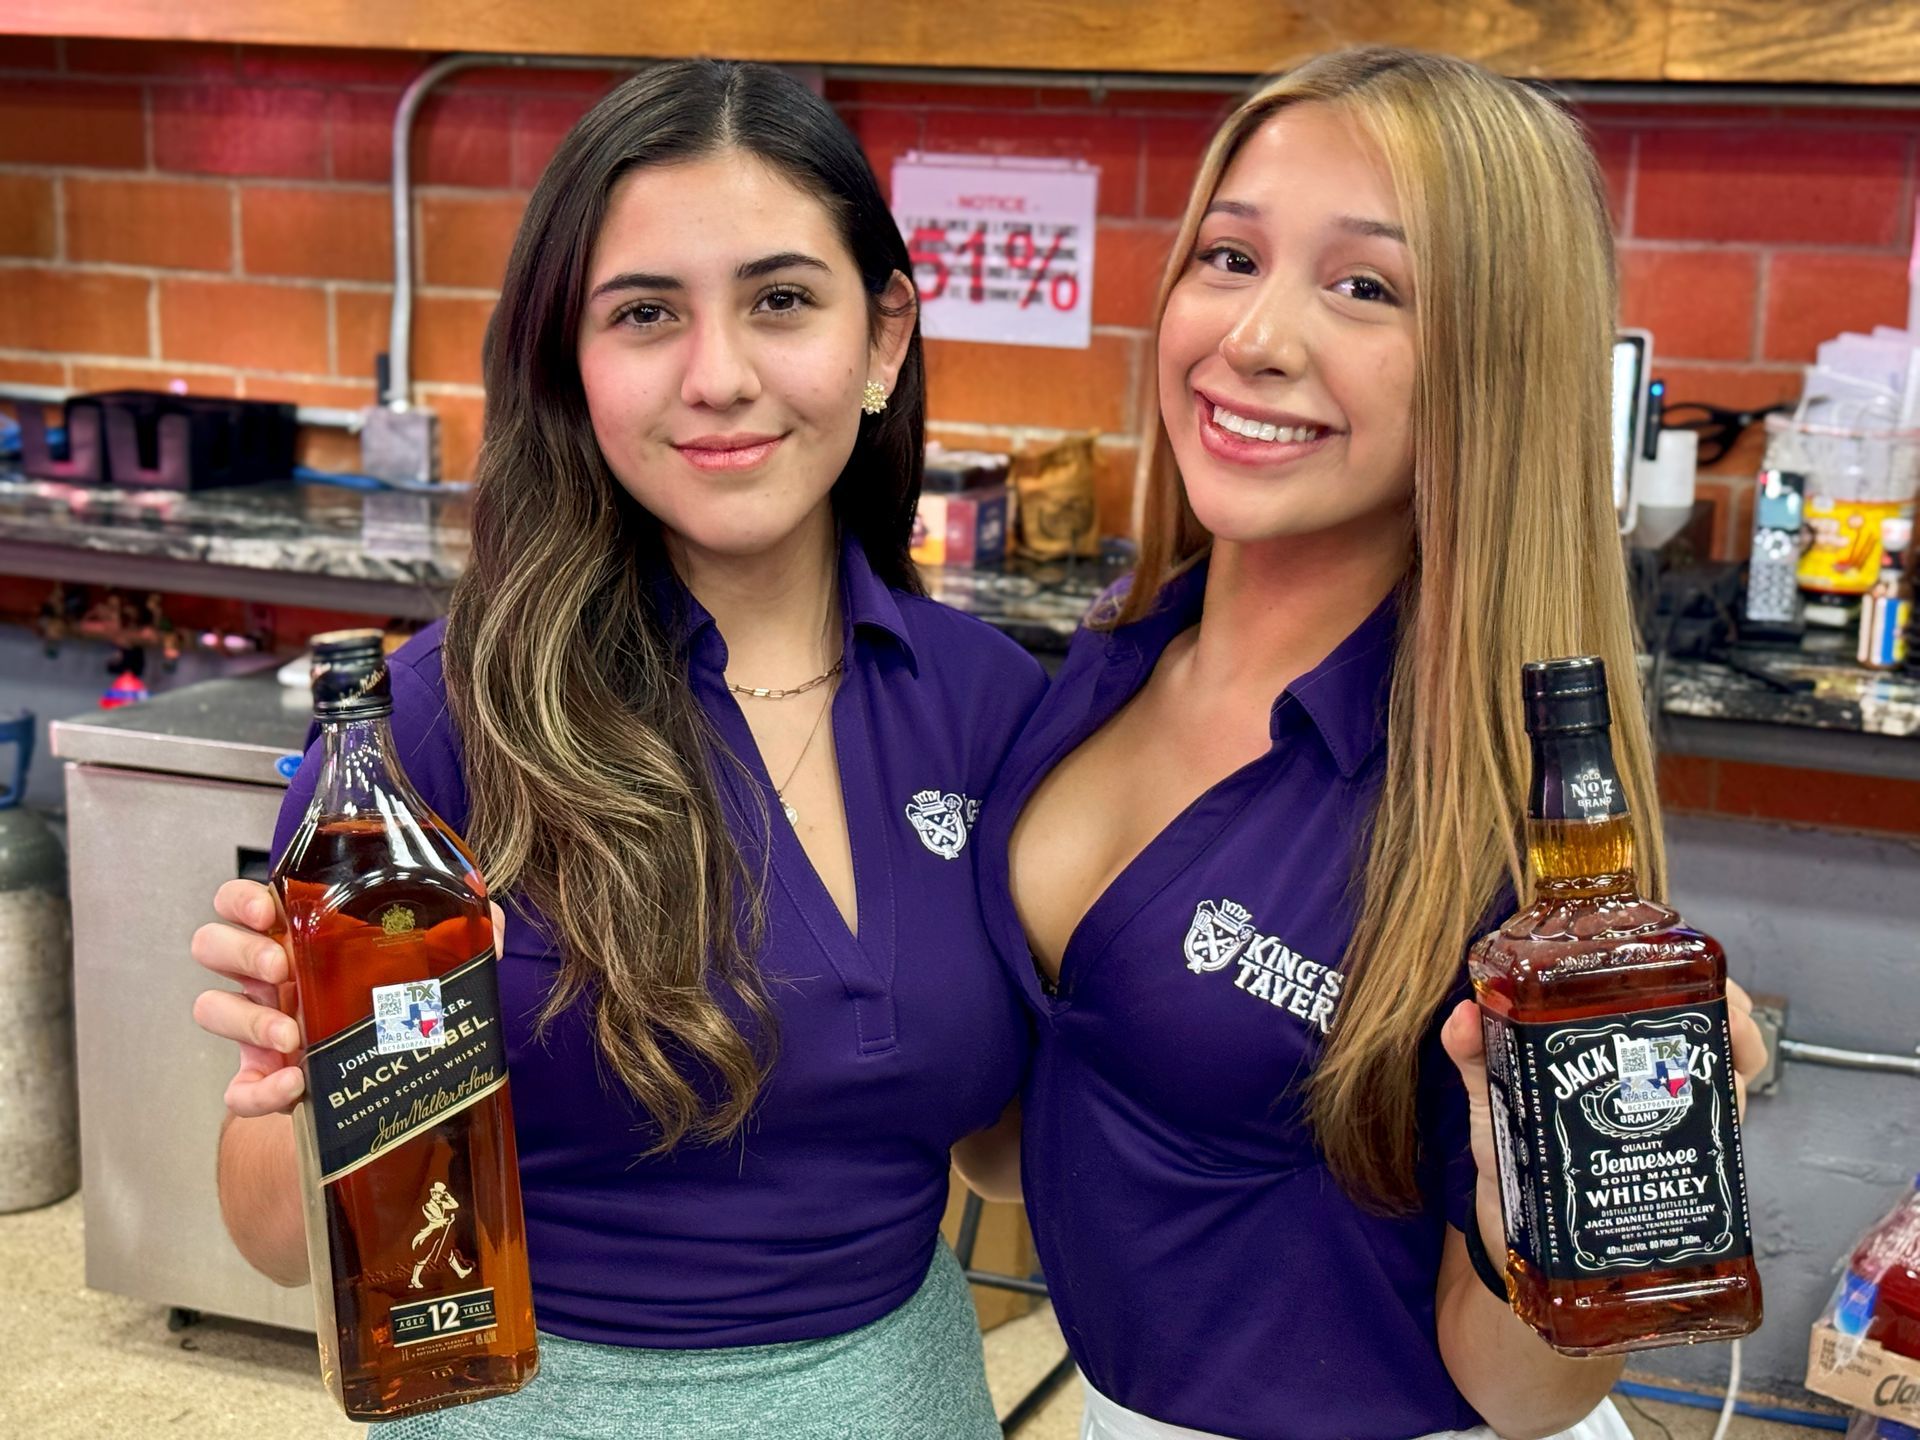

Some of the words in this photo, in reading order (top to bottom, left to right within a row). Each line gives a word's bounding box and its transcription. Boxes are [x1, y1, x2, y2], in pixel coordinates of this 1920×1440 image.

[958, 196, 1027, 213] NOTICE
[908, 227, 1079, 312] 51%
[1582, 772, 1600, 781] OLD
[1577, 796, 1612, 808] BRAND
[1243, 934, 1344, 997] KING'S
[407, 984, 435, 1002] TX
[1234, 956, 1333, 1034] TAVER
[328, 1056, 409, 1109] BLACK
[412, 1014, 489, 1063] LABEL
[1526, 1043, 1537, 1082] EVERY
[1652, 1040, 1682, 1060] TX
[337, 1097, 390, 1130] BLENDED
[395, 1069, 440, 1097] SCOTCH
[444, 1041, 488, 1070] WHISKY
[1547, 1044, 1616, 1100] JACK
[371, 1111, 410, 1153] John
[407, 1087, 459, 1125] Walker
[1532, 1089, 1542, 1122] DROP
[1620, 1110, 1659, 1124] BRAND
[1537, 1127, 1548, 1163] MADE
[1621, 1140, 1663, 1153] QUALITY
[1590, 1148, 1698, 1176] Tennessee
[1601, 1174, 1641, 1186] SOUR
[1647, 1167, 1692, 1180] MASH
[1541, 1170, 1550, 1184] IN
[1586, 1175, 1709, 1209] WHISKEY
[1585, 1218, 1614, 1229] JACK
[1615, 1213, 1655, 1225] DANIEL
[1656, 1204, 1716, 1220] DISTILLERY
[1601, 1206, 1637, 1217] DISTILLED
[1640, 1203, 1654, 1212] AND
[1656, 1199, 1688, 1210] BOTTLED
[1689, 1198, 1698, 1206] BY
[1544, 1190, 1560, 1263] TENNESSEE
[1649, 1241, 1659, 1249] 80
[400, 1317, 425, 1328] AGED
[427, 1301, 460, 1331] 12
[463, 1303, 490, 1315] YEARS
